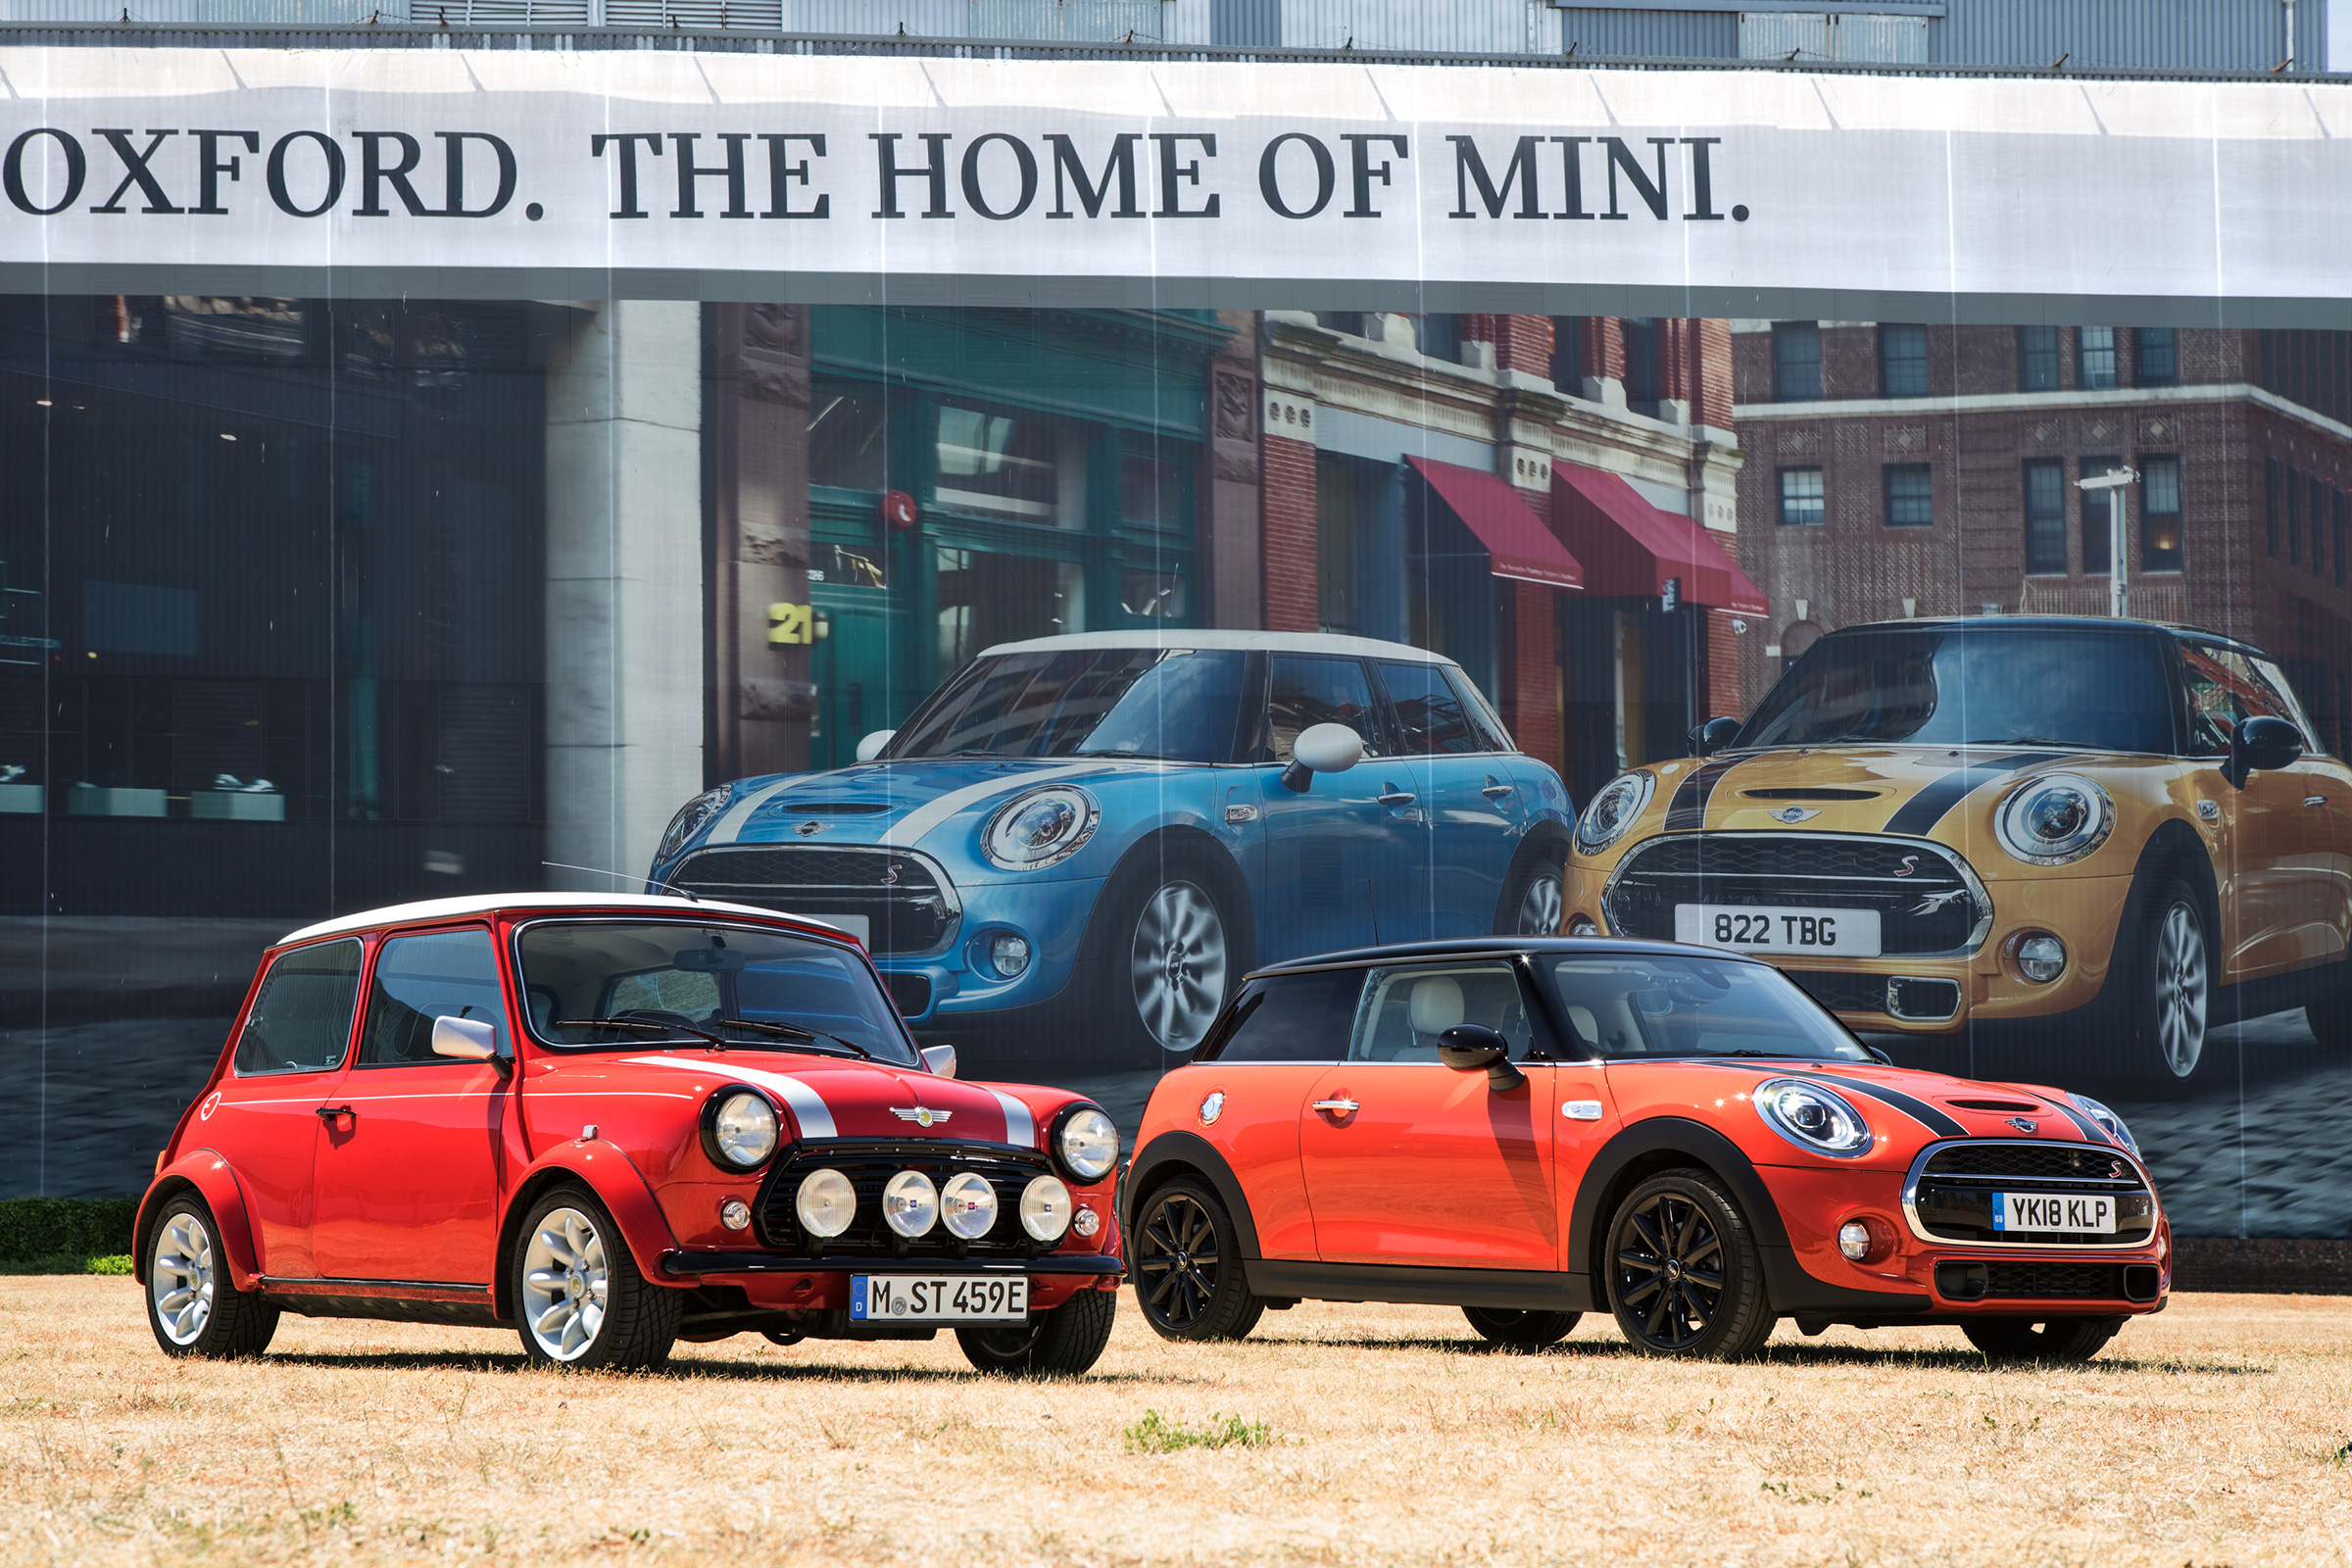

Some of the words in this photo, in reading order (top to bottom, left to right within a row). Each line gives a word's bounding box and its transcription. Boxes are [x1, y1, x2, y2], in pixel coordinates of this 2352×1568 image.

[3, 127, 544, 221] OXFORD.
[592, 132, 830, 220] THE
[868, 132, 1220, 220] HOME
[1258, 132, 1409, 220] OF
[1446, 135, 1750, 222] MINI.
[768, 602, 812, 645] 21
[880, 863, 903, 884] S
[1893, 856, 1918, 876] S
[1714, 913, 1771, 945] 822
[1781, 915, 1837, 947] TBG
[2108, 1159, 2122, 1179] S
[1994, 1214, 2004, 1223] GB
[2012, 1198, 2062, 1227] YK18
[2068, 1200, 2107, 1228] KLP
[855, 1301, 863, 1313] D
[871, 1280, 891, 1313] M
[909, 1281, 948, 1314] ST
[952, 1281, 1024, 1314] 459E
